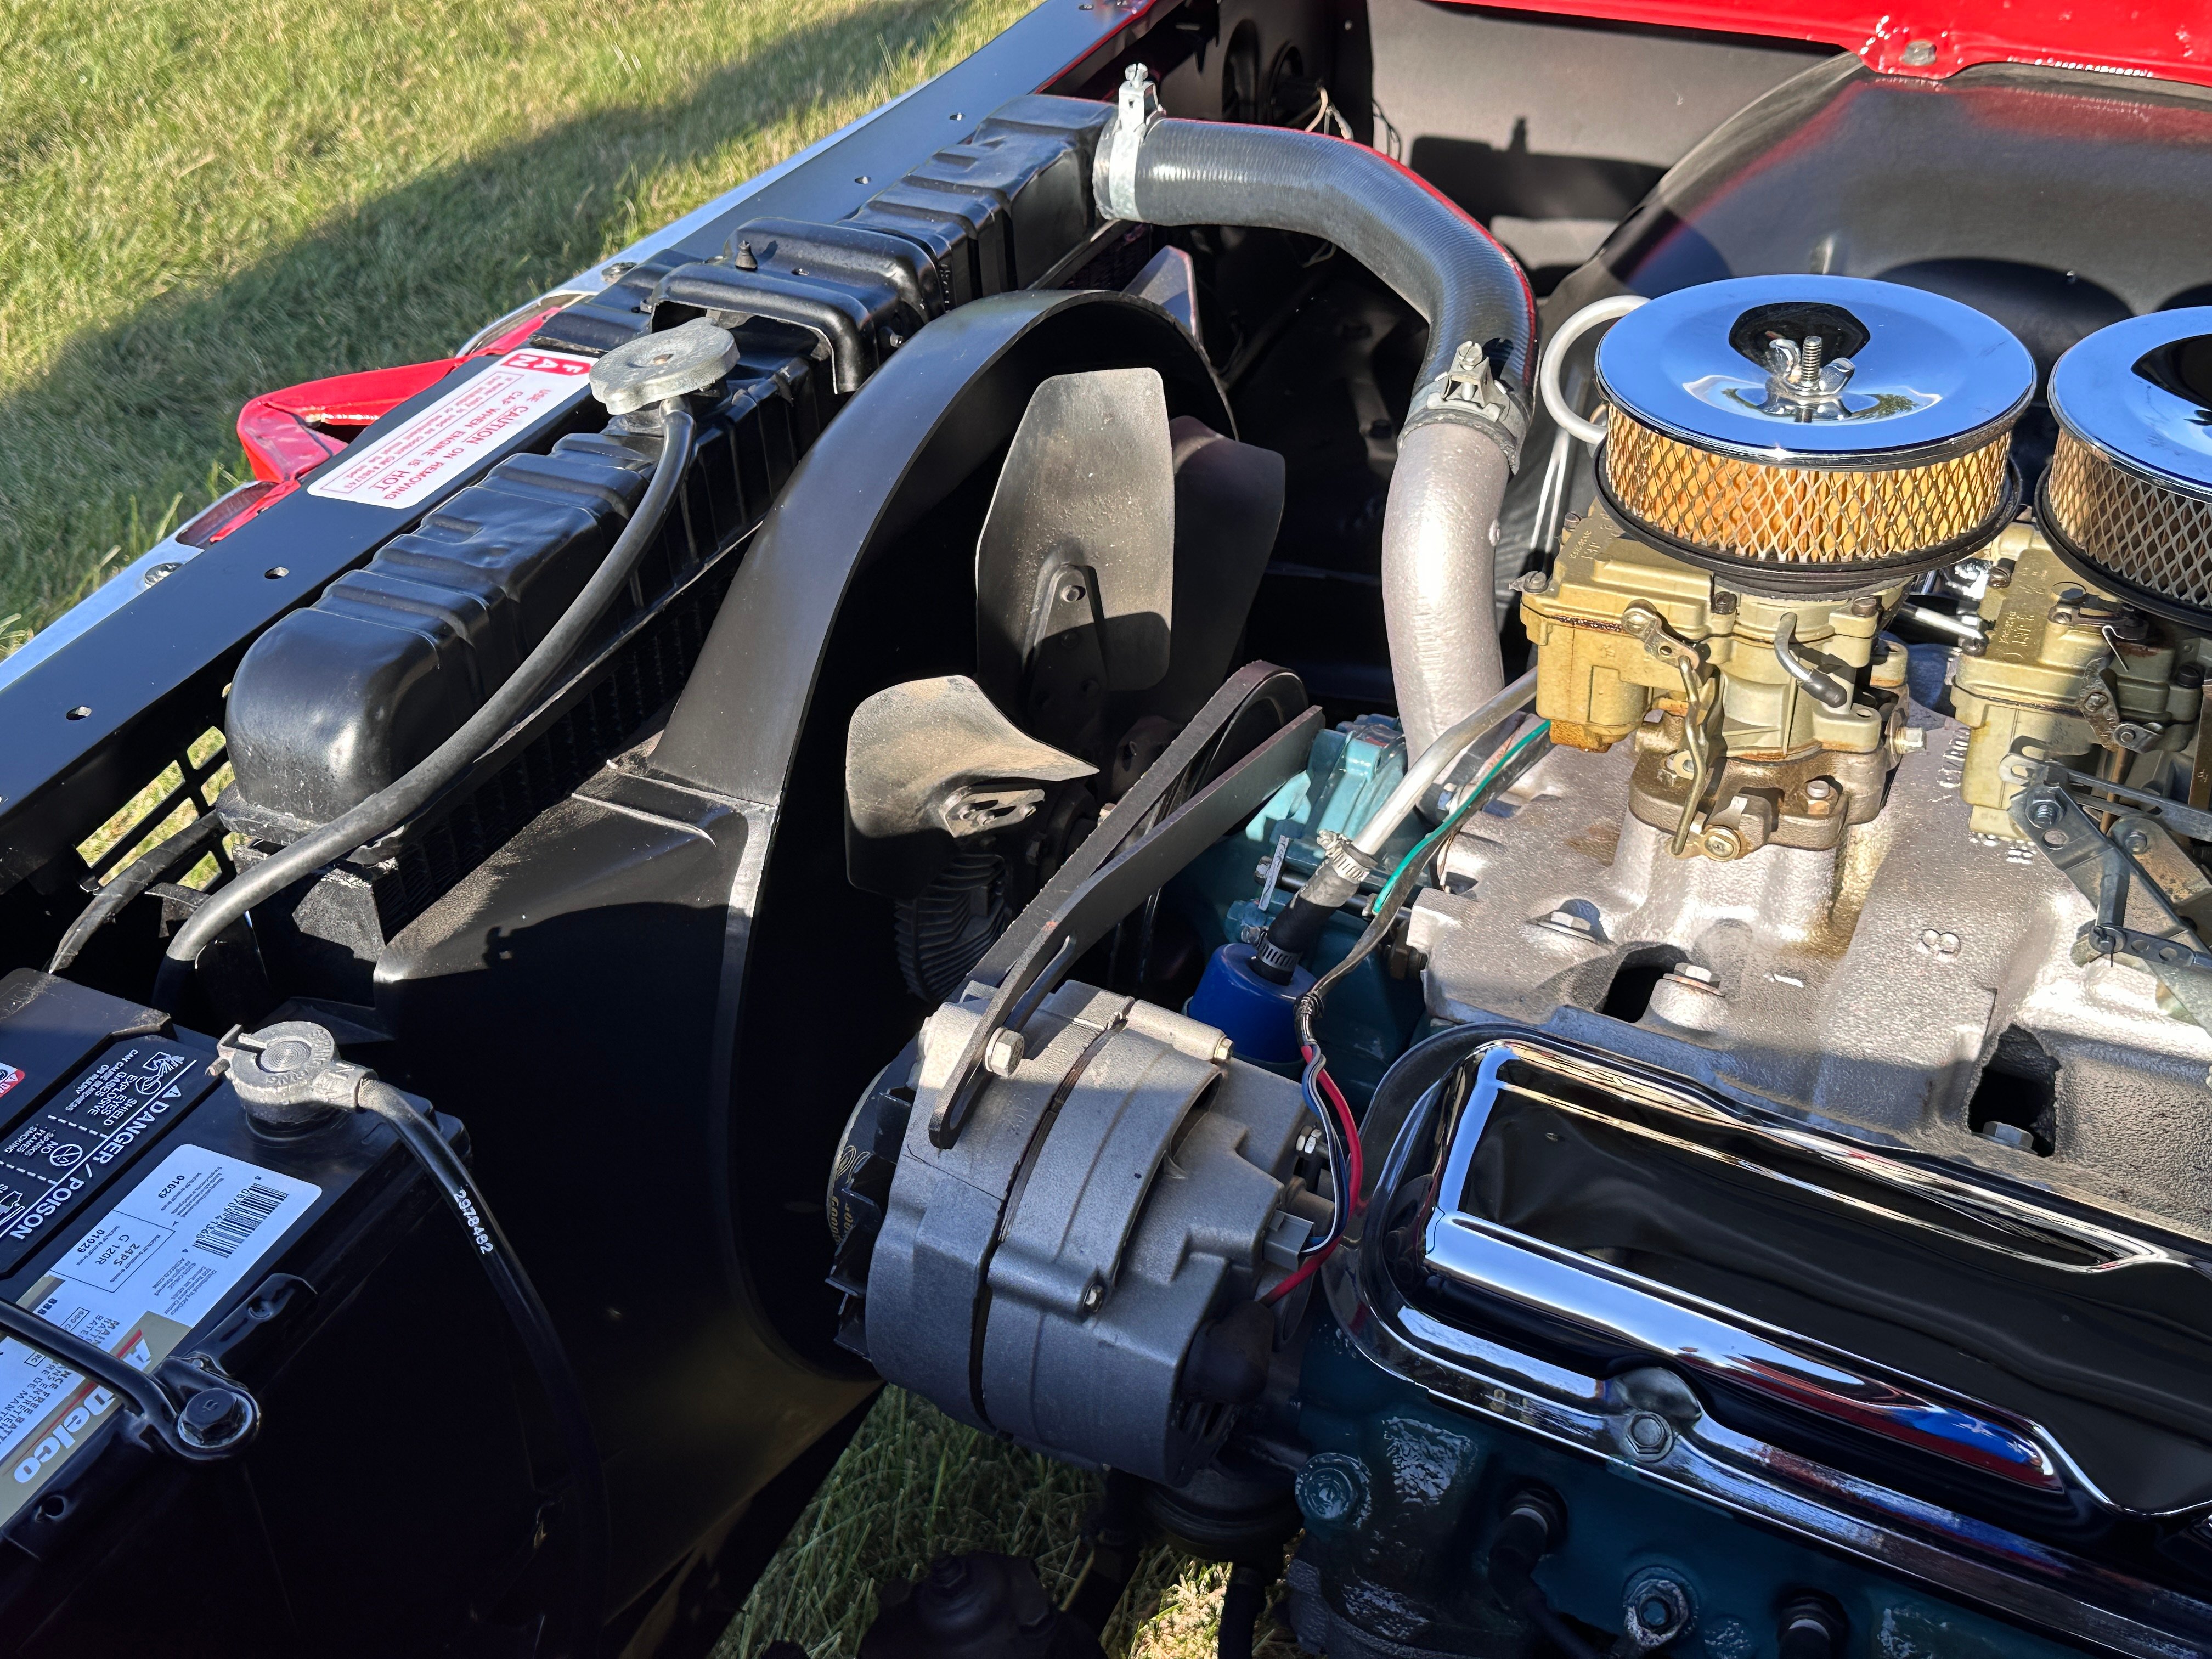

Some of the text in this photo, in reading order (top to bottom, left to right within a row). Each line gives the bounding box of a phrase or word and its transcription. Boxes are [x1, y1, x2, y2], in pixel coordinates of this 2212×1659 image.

[509, 354, 583, 374] FAN
[499, 390, 524, 405] CAP
[463, 407, 500, 428] WHEN
[465, 405, 530, 445] CAUTION
[422, 430, 467, 457] ENGINE
[442, 447, 466, 459] ON
[371, 469, 410, 492] HOT
[382, 461, 444, 500] REMOVING
[87, 1074, 138, 1116] EXPLOSIVE
[94, 1071, 127, 1097] GASES
[101, 1094, 127, 1115] EYES
[103, 1098, 137, 1125] SHIELD
[4, 1126, 37, 1153] SMOKING
[16, 1129, 46, 1153] FLAMES
[24, 1132, 54, 1156] SPARKS
[93, 1101, 170, 1164] DANGER
[41, 1141, 58, 1154] NO
[158, 1175, 185, 1198] 01029
[9, 1177, 84, 1239] POISON
[453, 1189, 493, 1254] 2978482
[77, 1229, 105, 1252] 01029
[95, 1245, 120, 1265] 120R
[113, 1243, 140, 1266] 24PS
[27, 1377, 43, 1389] DE
[24, 1391, 50, 1414] FREE
